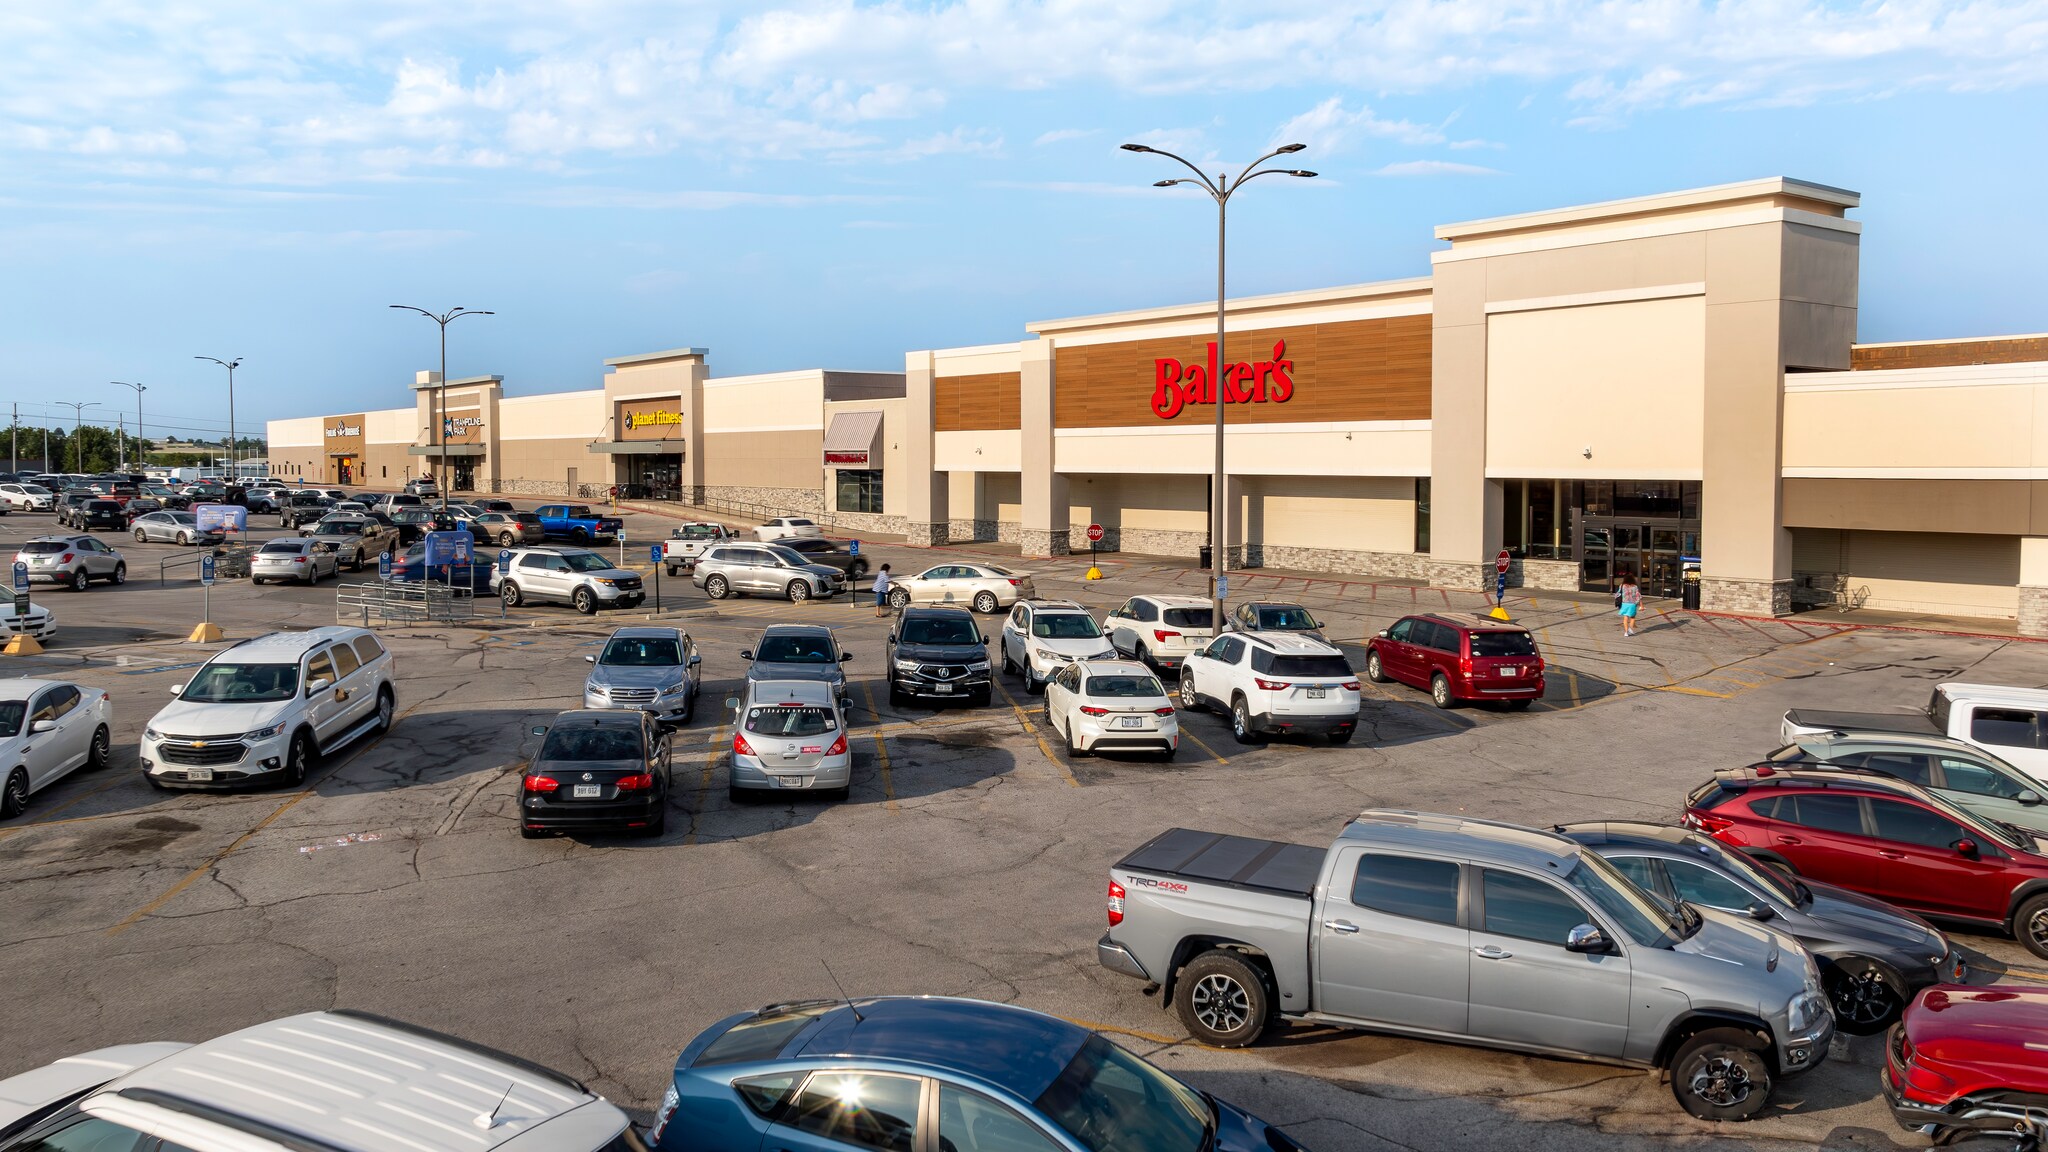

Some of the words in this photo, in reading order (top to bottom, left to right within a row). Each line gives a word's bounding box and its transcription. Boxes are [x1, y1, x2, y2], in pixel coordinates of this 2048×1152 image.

[1151, 339, 1294, 419] Baker's
[453, 417, 481, 427] TRAMPOLINE
[632, 411, 656, 429] planet
[657, 410, 683, 425] fitness
[453, 428, 467, 436] PARK
[1088, 528, 1103, 537] STOP
[1497, 557, 1509, 567] STOP
[1127, 876, 1158, 887] TRD
